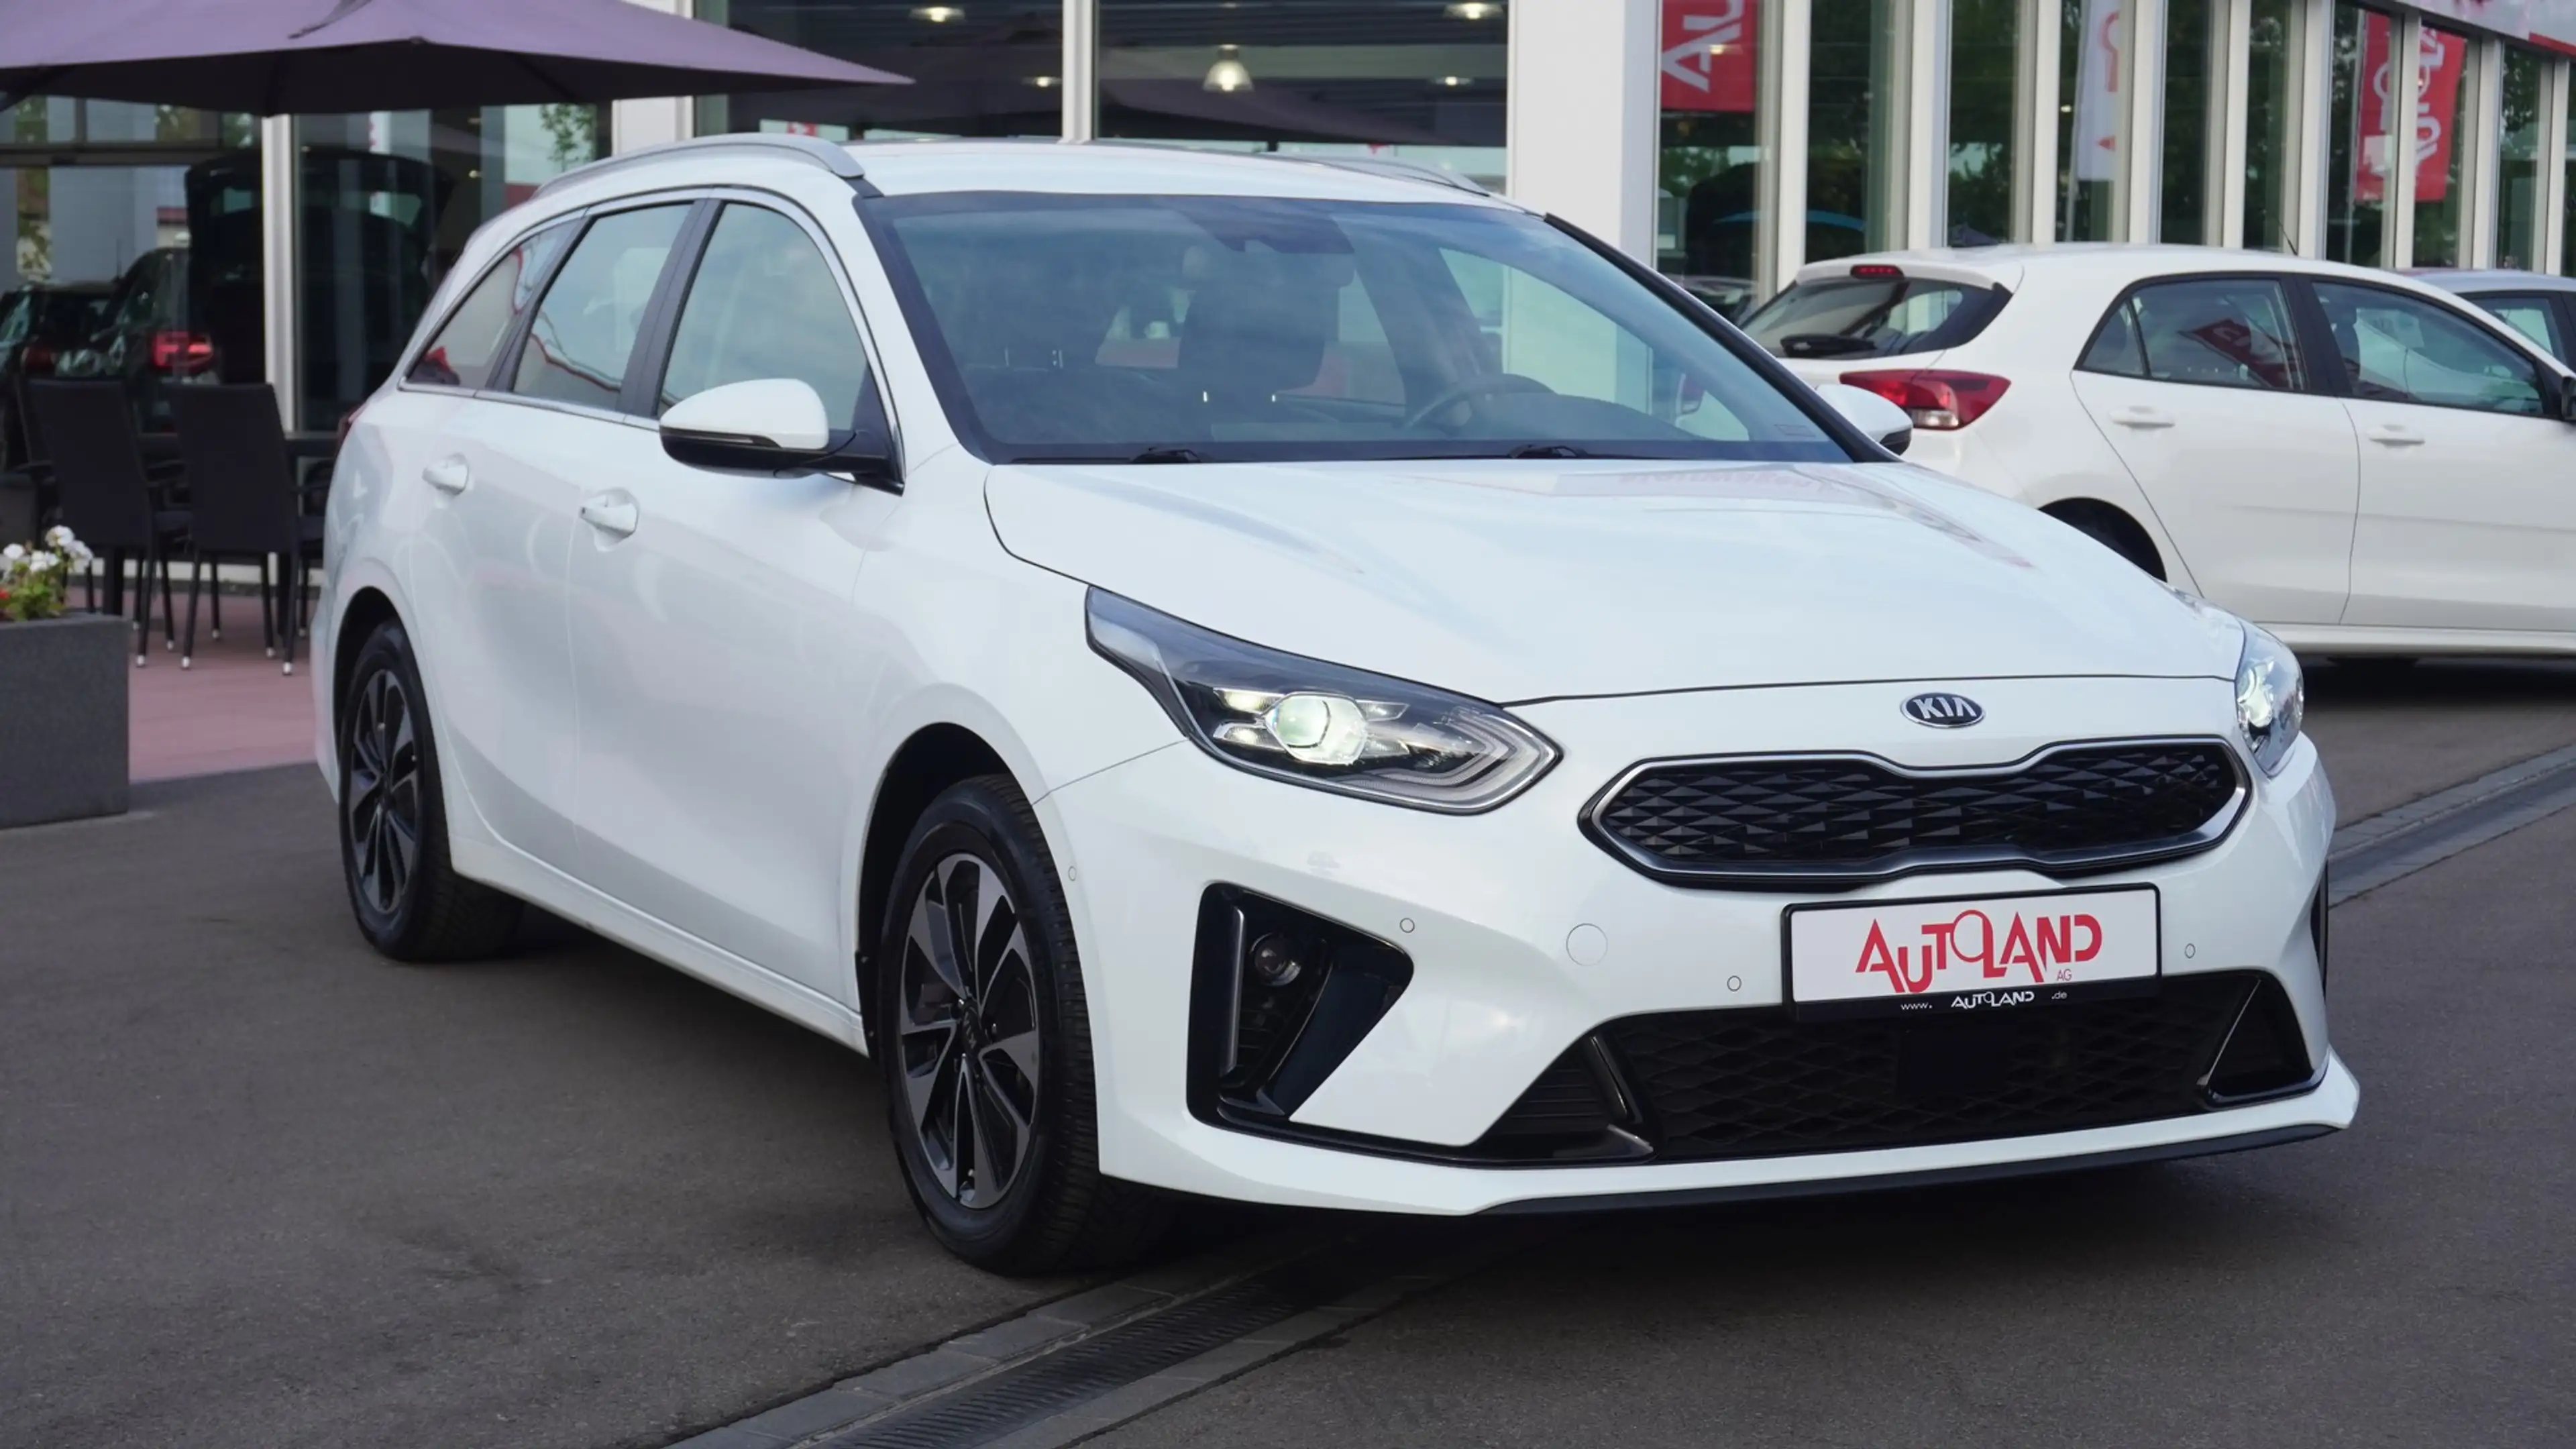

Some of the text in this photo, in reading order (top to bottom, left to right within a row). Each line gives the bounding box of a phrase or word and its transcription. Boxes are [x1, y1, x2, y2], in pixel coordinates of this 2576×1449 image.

[1912, 696, 1978, 719] KIA
[1856, 910, 2102, 993] AUTOLAND
[2056, 969, 2072, 981] AG
[1901, 991, 2068, 1010] www. AUTOLAND .de
